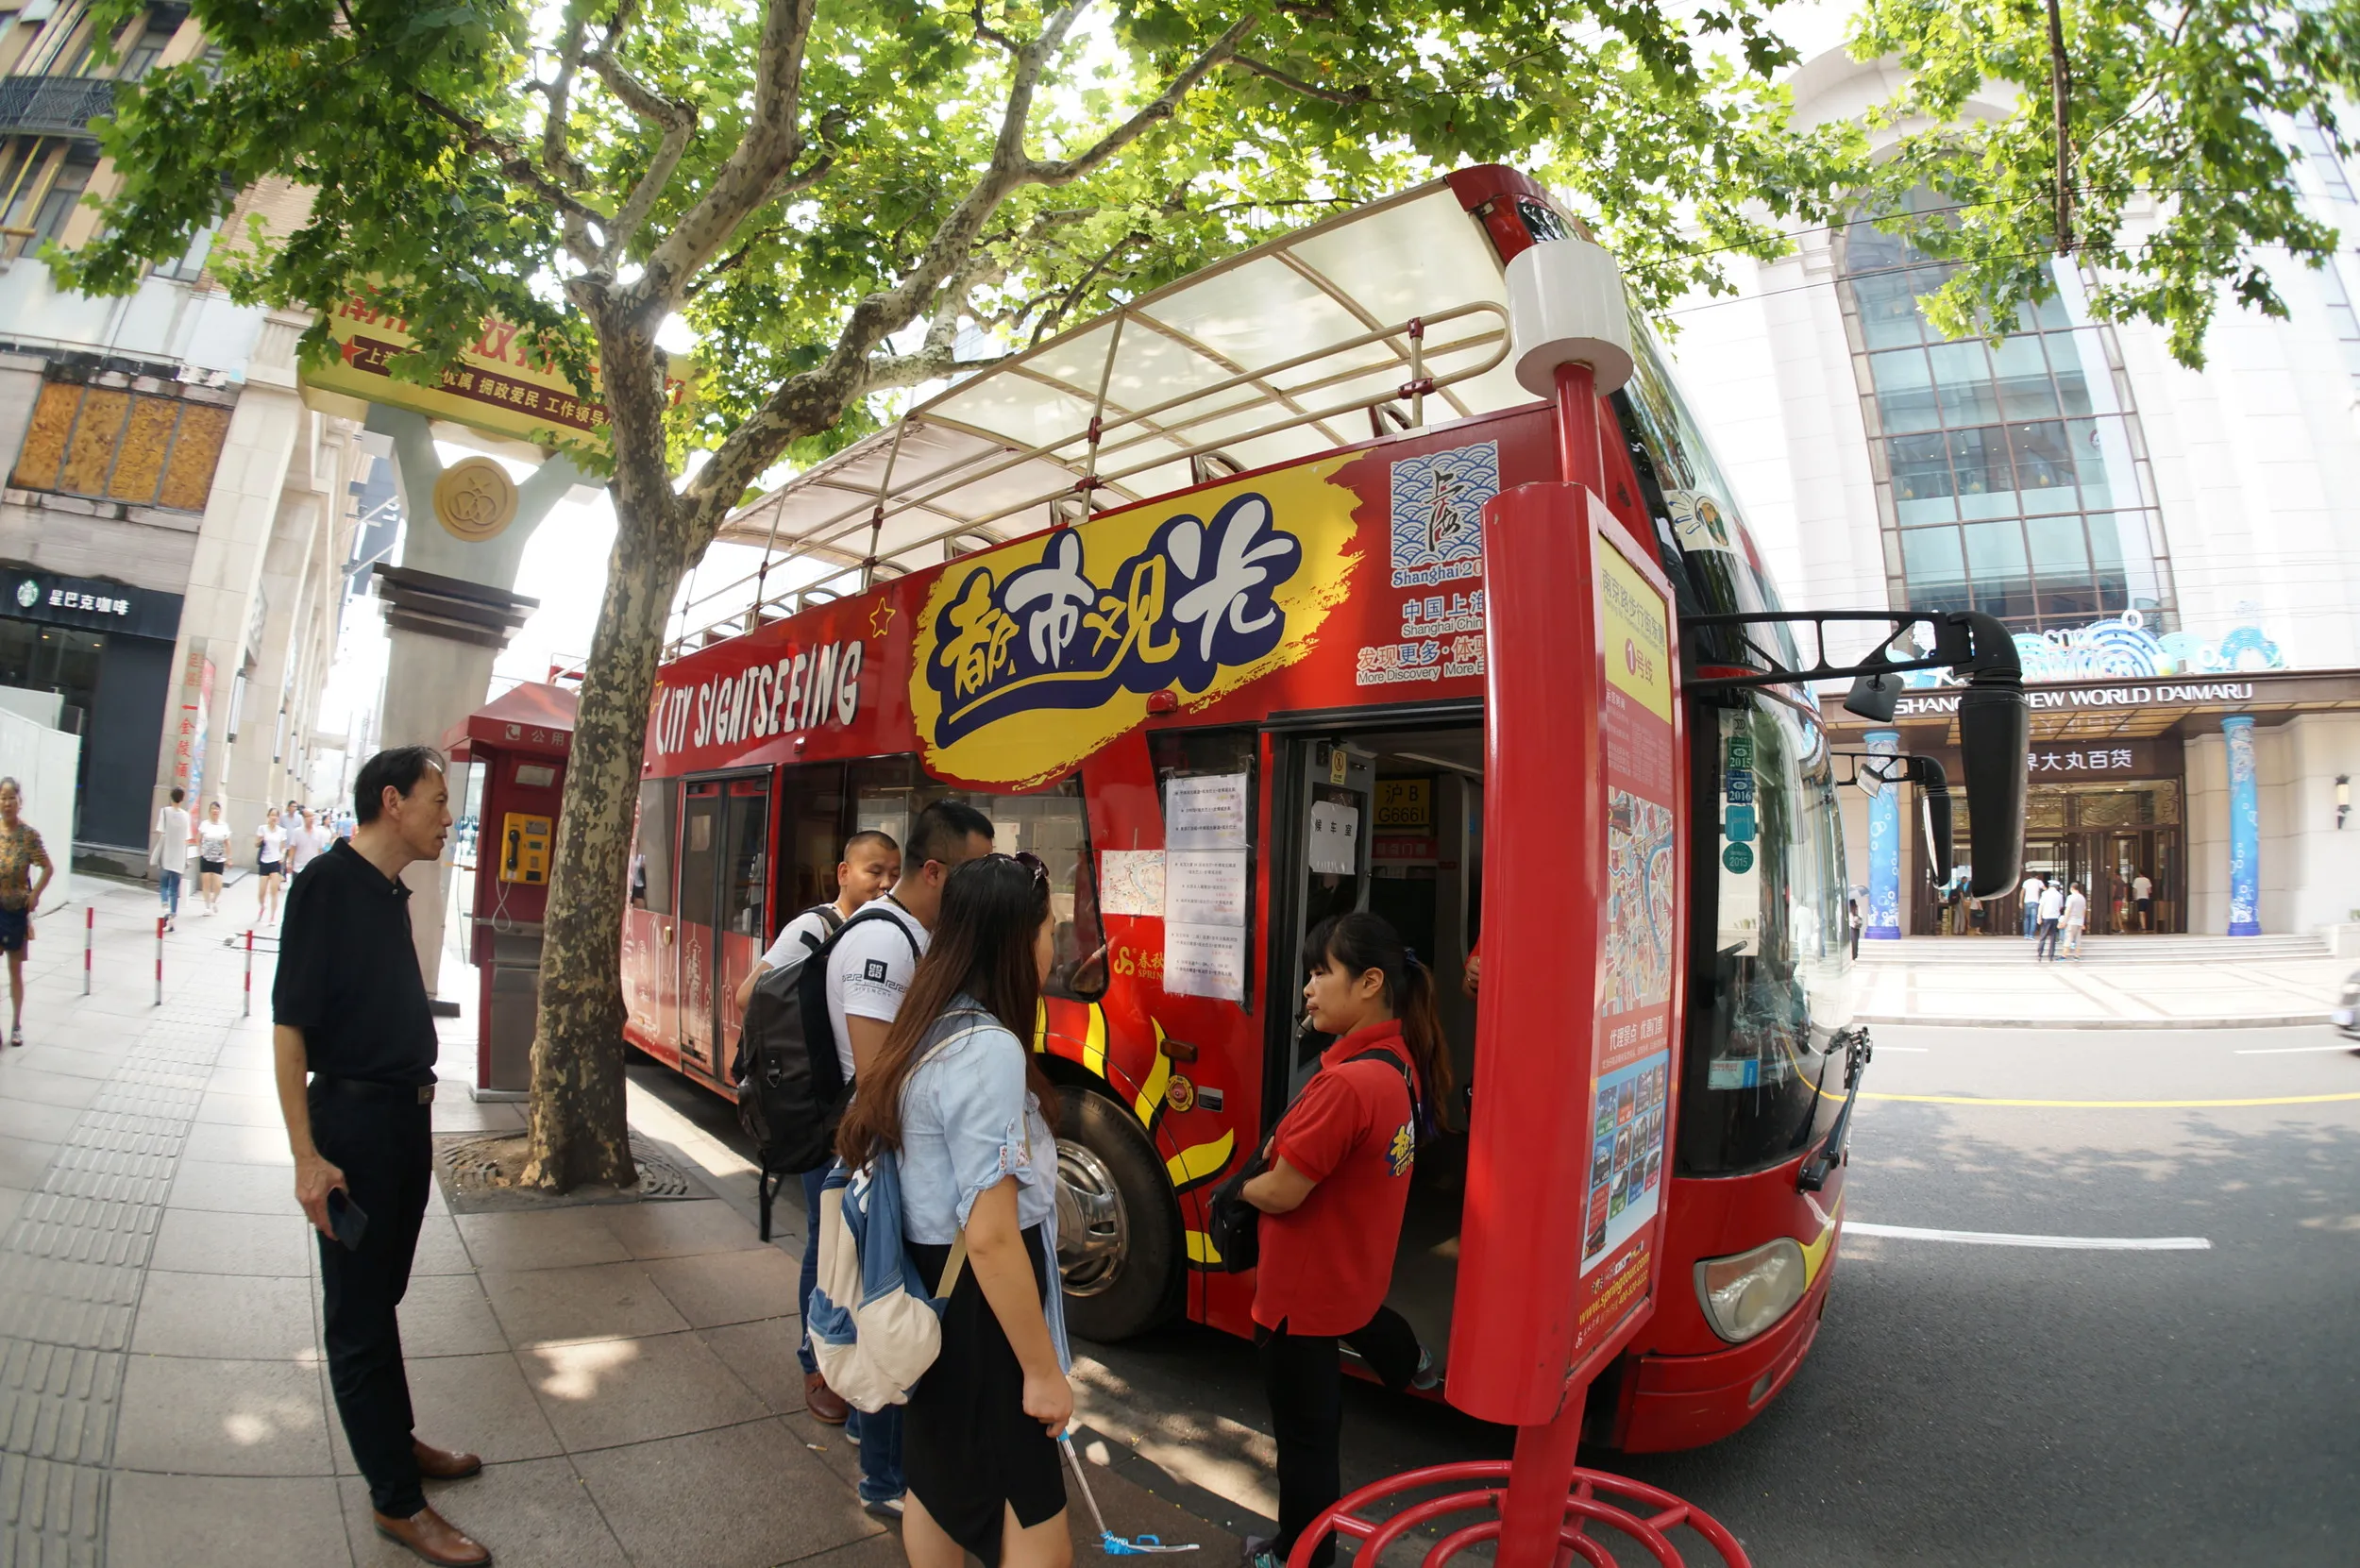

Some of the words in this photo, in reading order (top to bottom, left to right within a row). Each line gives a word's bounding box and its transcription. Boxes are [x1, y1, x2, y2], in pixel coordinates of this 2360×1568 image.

[479, 377, 540, 409] 拥政爱民
[1392, 564, 1459, 586] Shanghai
[1461, 562, 1482, 577] 20
[49, 589, 130, 615] 星巴克咖啡
[940, 498, 1294, 701] 都市观光
[1403, 619, 1454, 636] Shanghai
[1457, 616, 1483, 630] Chin
[1358, 671, 1384, 684] More
[1387, 666, 1440, 681] Discovery
[1445, 662, 1474, 676] More
[656, 685, 694, 755] CITY
[694, 640, 862, 748] SIGHTSEEING
[1894, 696, 1963, 715] SHAN
[2069, 687, 2151, 705] WORLD
[2156, 683, 2253, 702] DAIMARU
[531, 729, 574, 747] 公用
[1729, 757, 1752, 767] 2015
[1729, 791, 1752, 801] 2016
[1729, 856, 1748, 868] 2015
[1138, 969, 1164, 981] SPRIN
[854, 986, 892, 998] GIVENCHY
